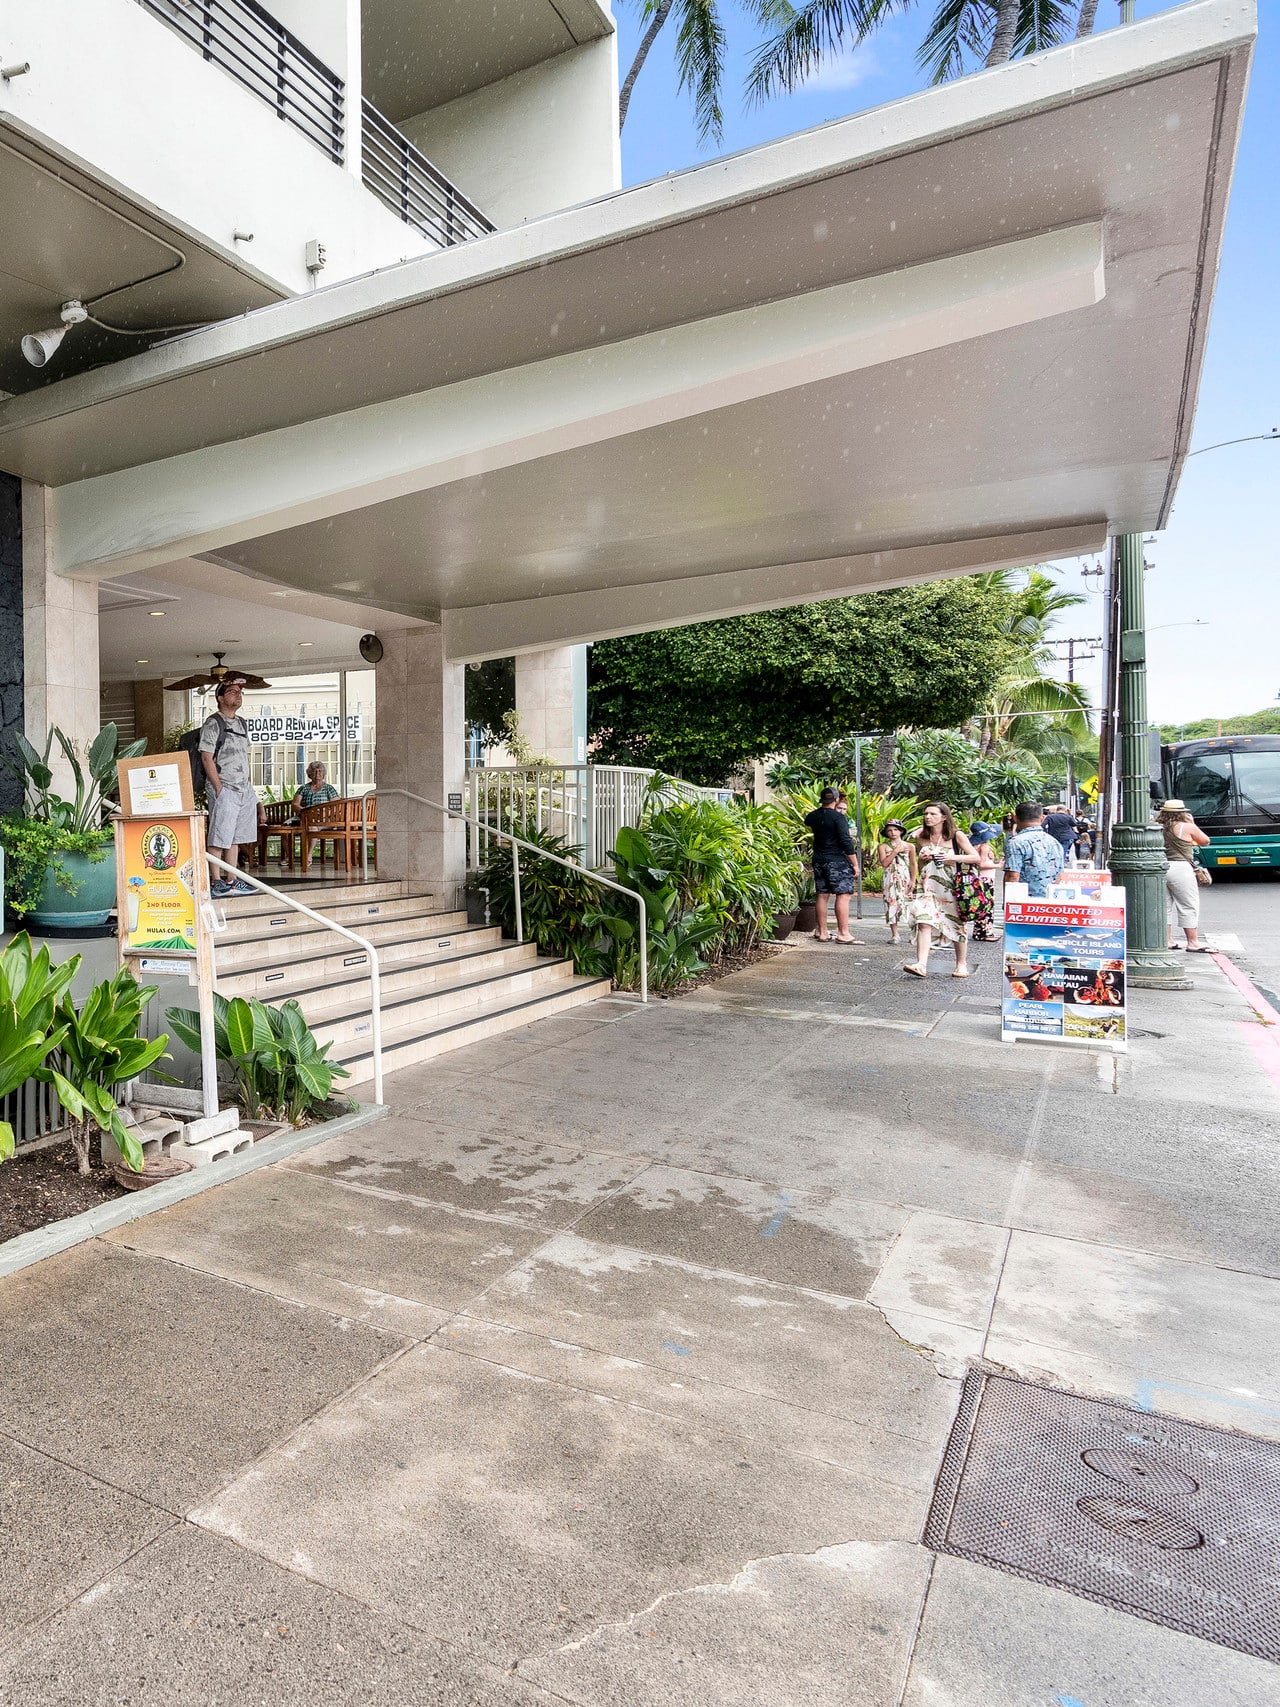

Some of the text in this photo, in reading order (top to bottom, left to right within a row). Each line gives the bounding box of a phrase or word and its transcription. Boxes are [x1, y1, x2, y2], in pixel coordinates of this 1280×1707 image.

[246, 715, 360, 732] BOARD RENTAL SPCE
[251, 730, 357, 742] 808-924-778
[1026, 905, 1102, 916] DISCOUNTED
[1008, 914, 1122, 927] ACTIVITIES & TOURS
[1056, 939, 1122, 949] CIRCLE ISLAND
[1073, 947, 1105, 956] TOURS
[1043, 972, 1088, 982] HAWAIIAN
